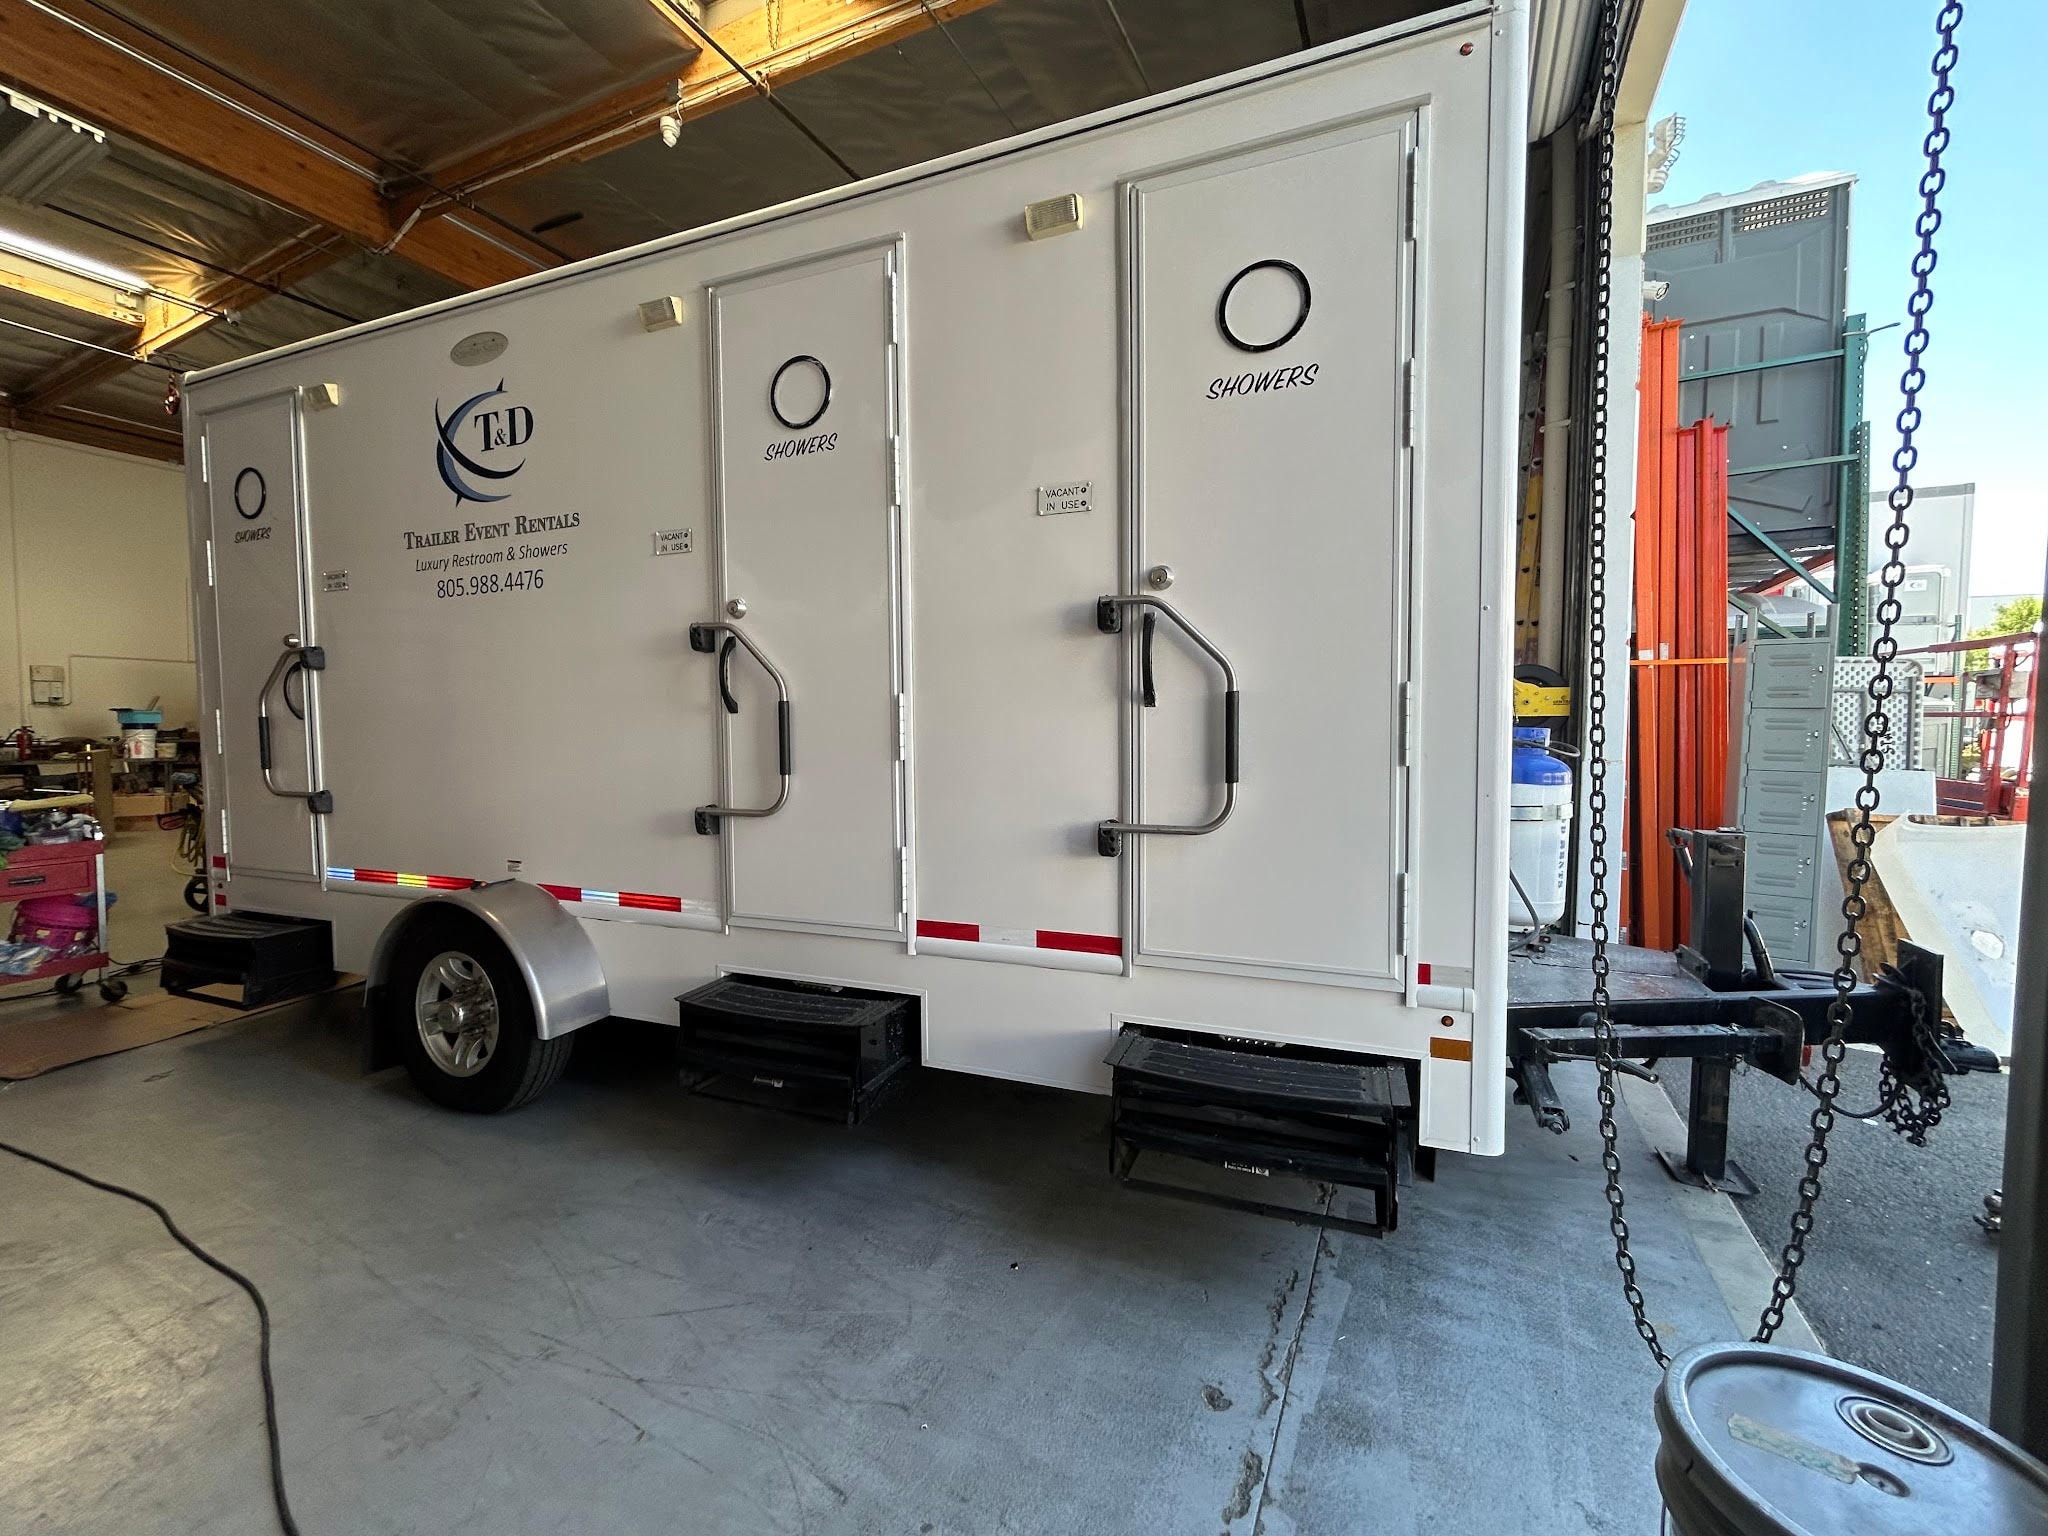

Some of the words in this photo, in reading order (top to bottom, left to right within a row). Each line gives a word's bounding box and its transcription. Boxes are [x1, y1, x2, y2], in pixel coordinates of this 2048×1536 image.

[1205, 363, 1319, 399] SHOWERS
[474, 406, 534, 452] T&D
[764, 432, 838, 461] SHOWERS
[1045, 486, 1080, 498] VACANT
[1046, 502, 1056, 511] IN
[1061, 499, 1080, 510] USE
[234, 527, 272, 544] SHOWERS
[404, 531, 460, 550] TRAILER
[464, 522, 510, 542] EVENT
[514, 512, 581, 535] RENTALS
[660, 531, 684, 541] VACANT
[416, 557, 450, 572] Luxury
[452, 550, 504, 568] Restroom
[506, 546, 516, 561] &
[519, 543, 569, 560] Showers
[671, 543, 684, 551] USE
[437, 569, 545, 599] 805.988.4476
